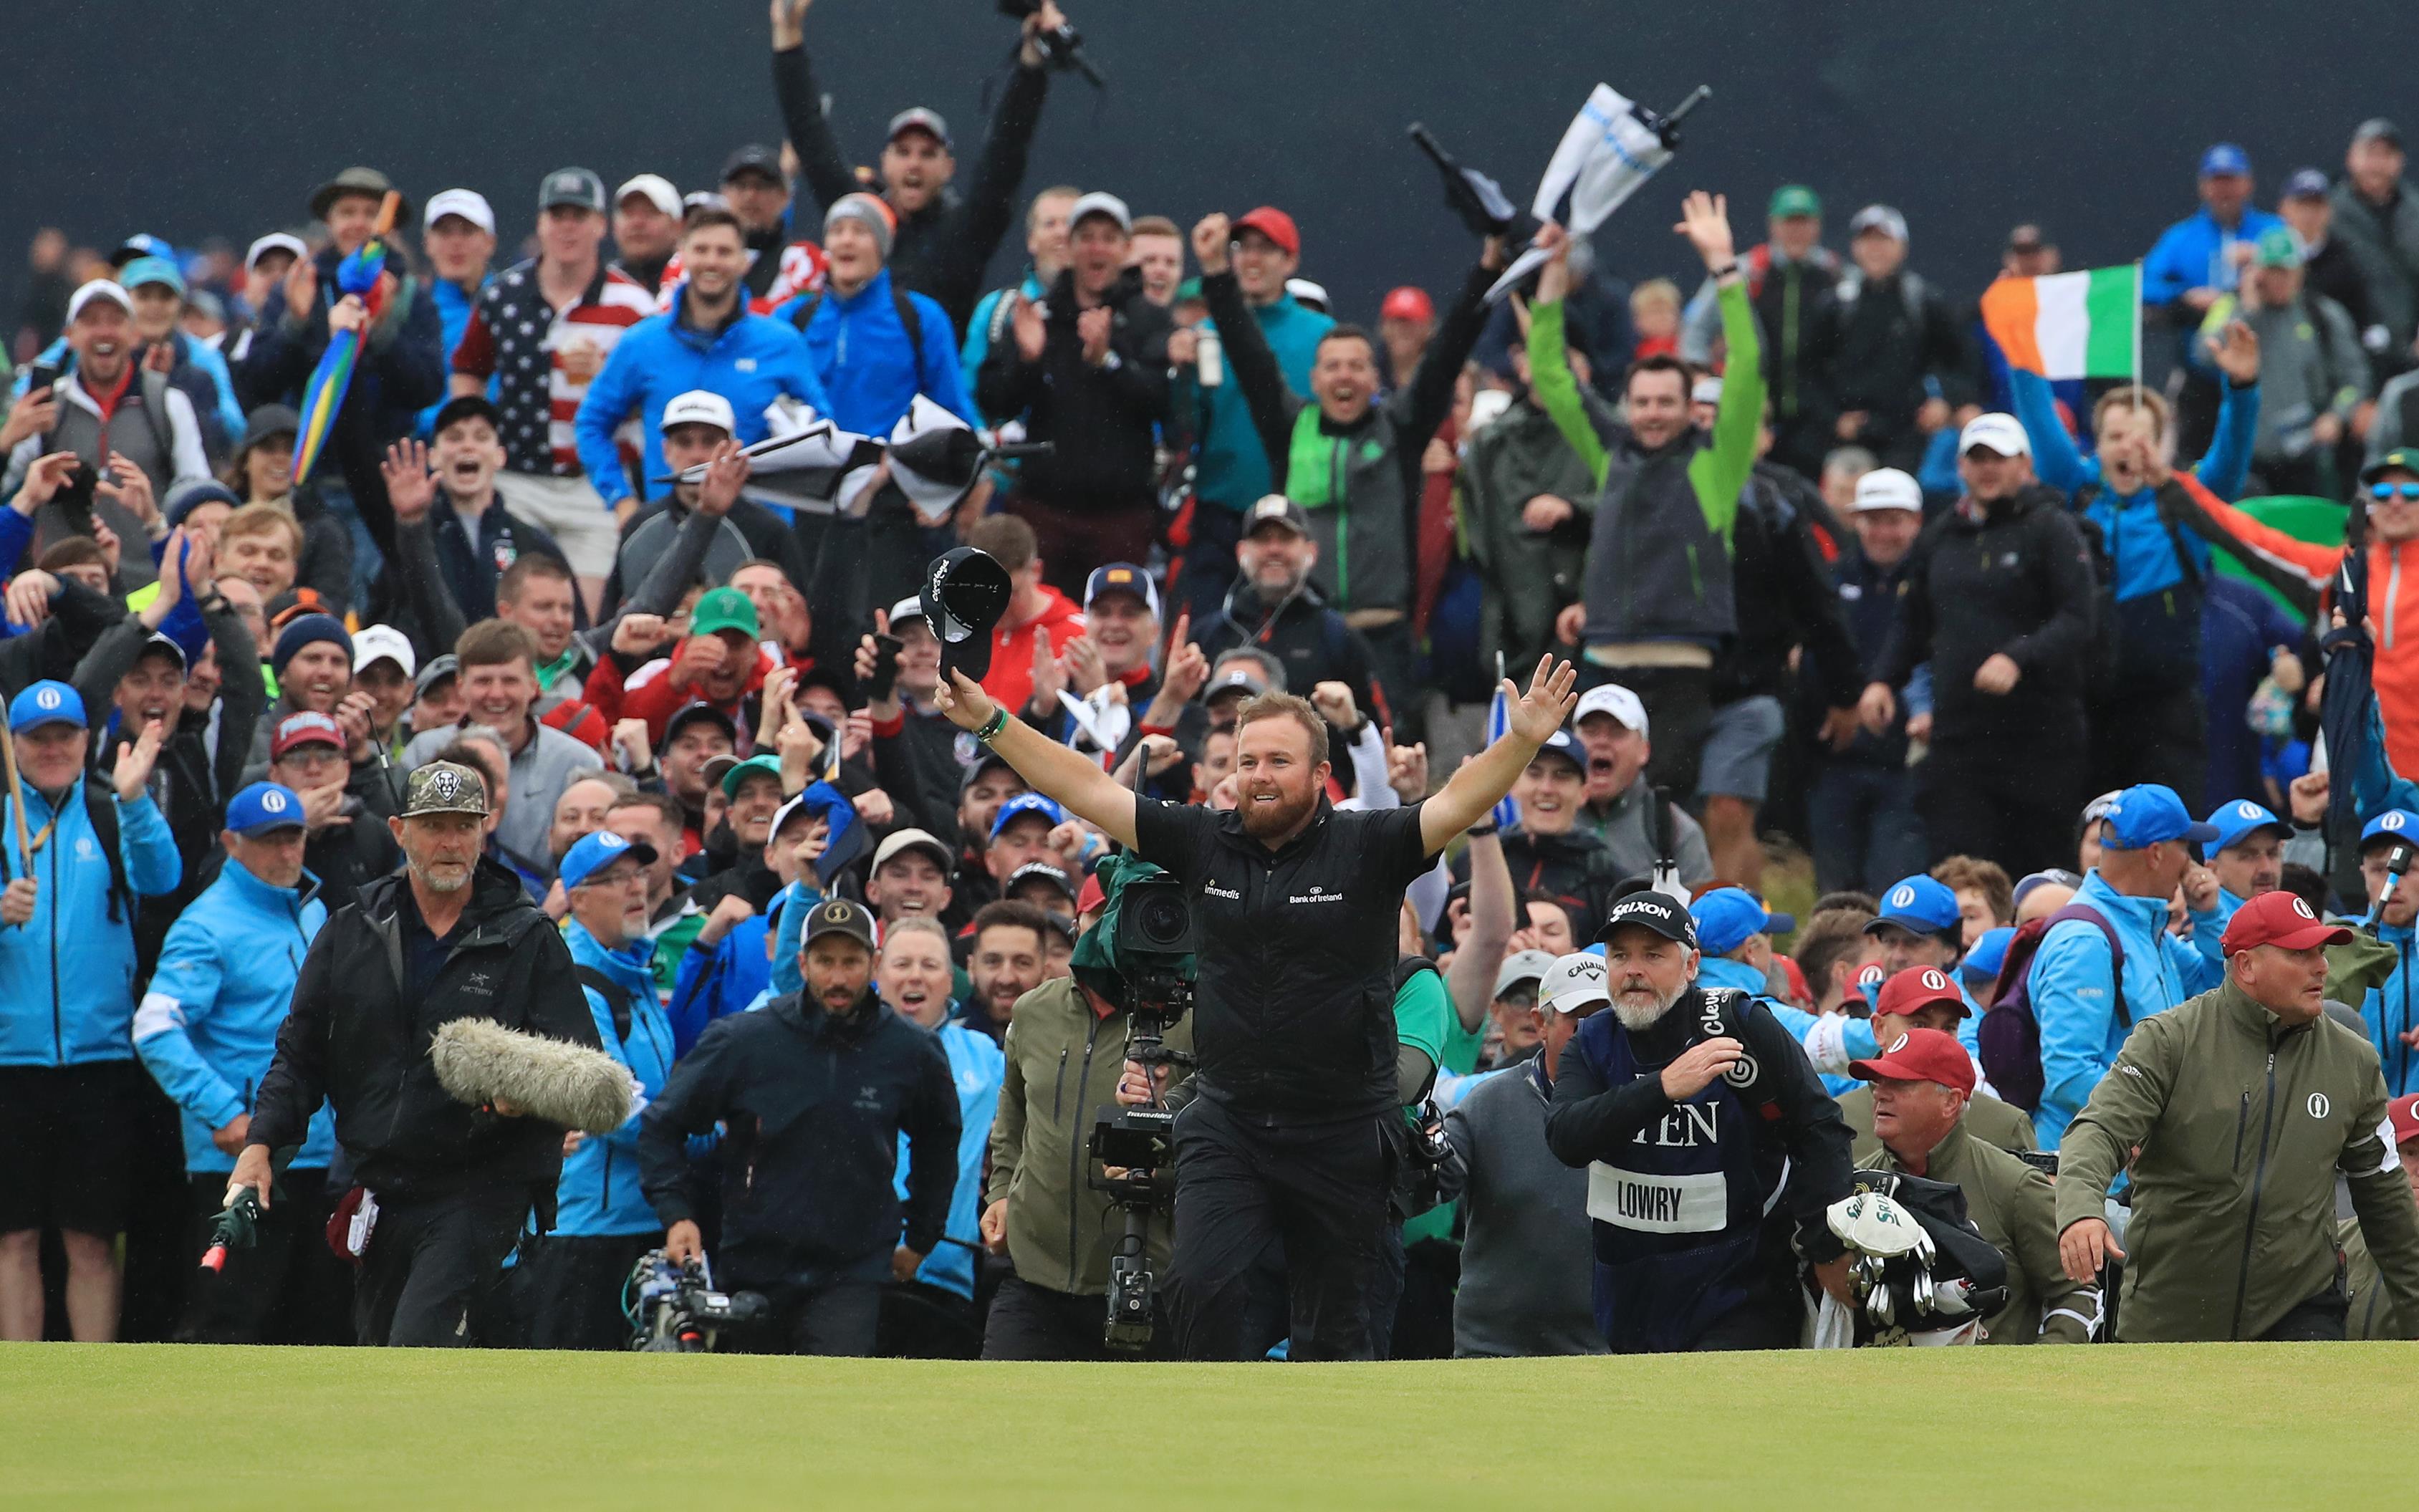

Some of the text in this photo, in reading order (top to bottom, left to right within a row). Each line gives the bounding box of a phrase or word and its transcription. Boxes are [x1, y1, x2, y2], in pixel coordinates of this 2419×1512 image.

[1204, 884, 1240, 900] immedis
[1289, 895, 1309, 904] Bank
[1318, 892, 1343, 902] Ireland
[1610, 901, 1673, 923] SRIXON
[1700, 986, 1725, 1036] Cleve
[1632, 1101, 1720, 1147] EN
[1617, 1180, 1682, 1222] LOWRY
